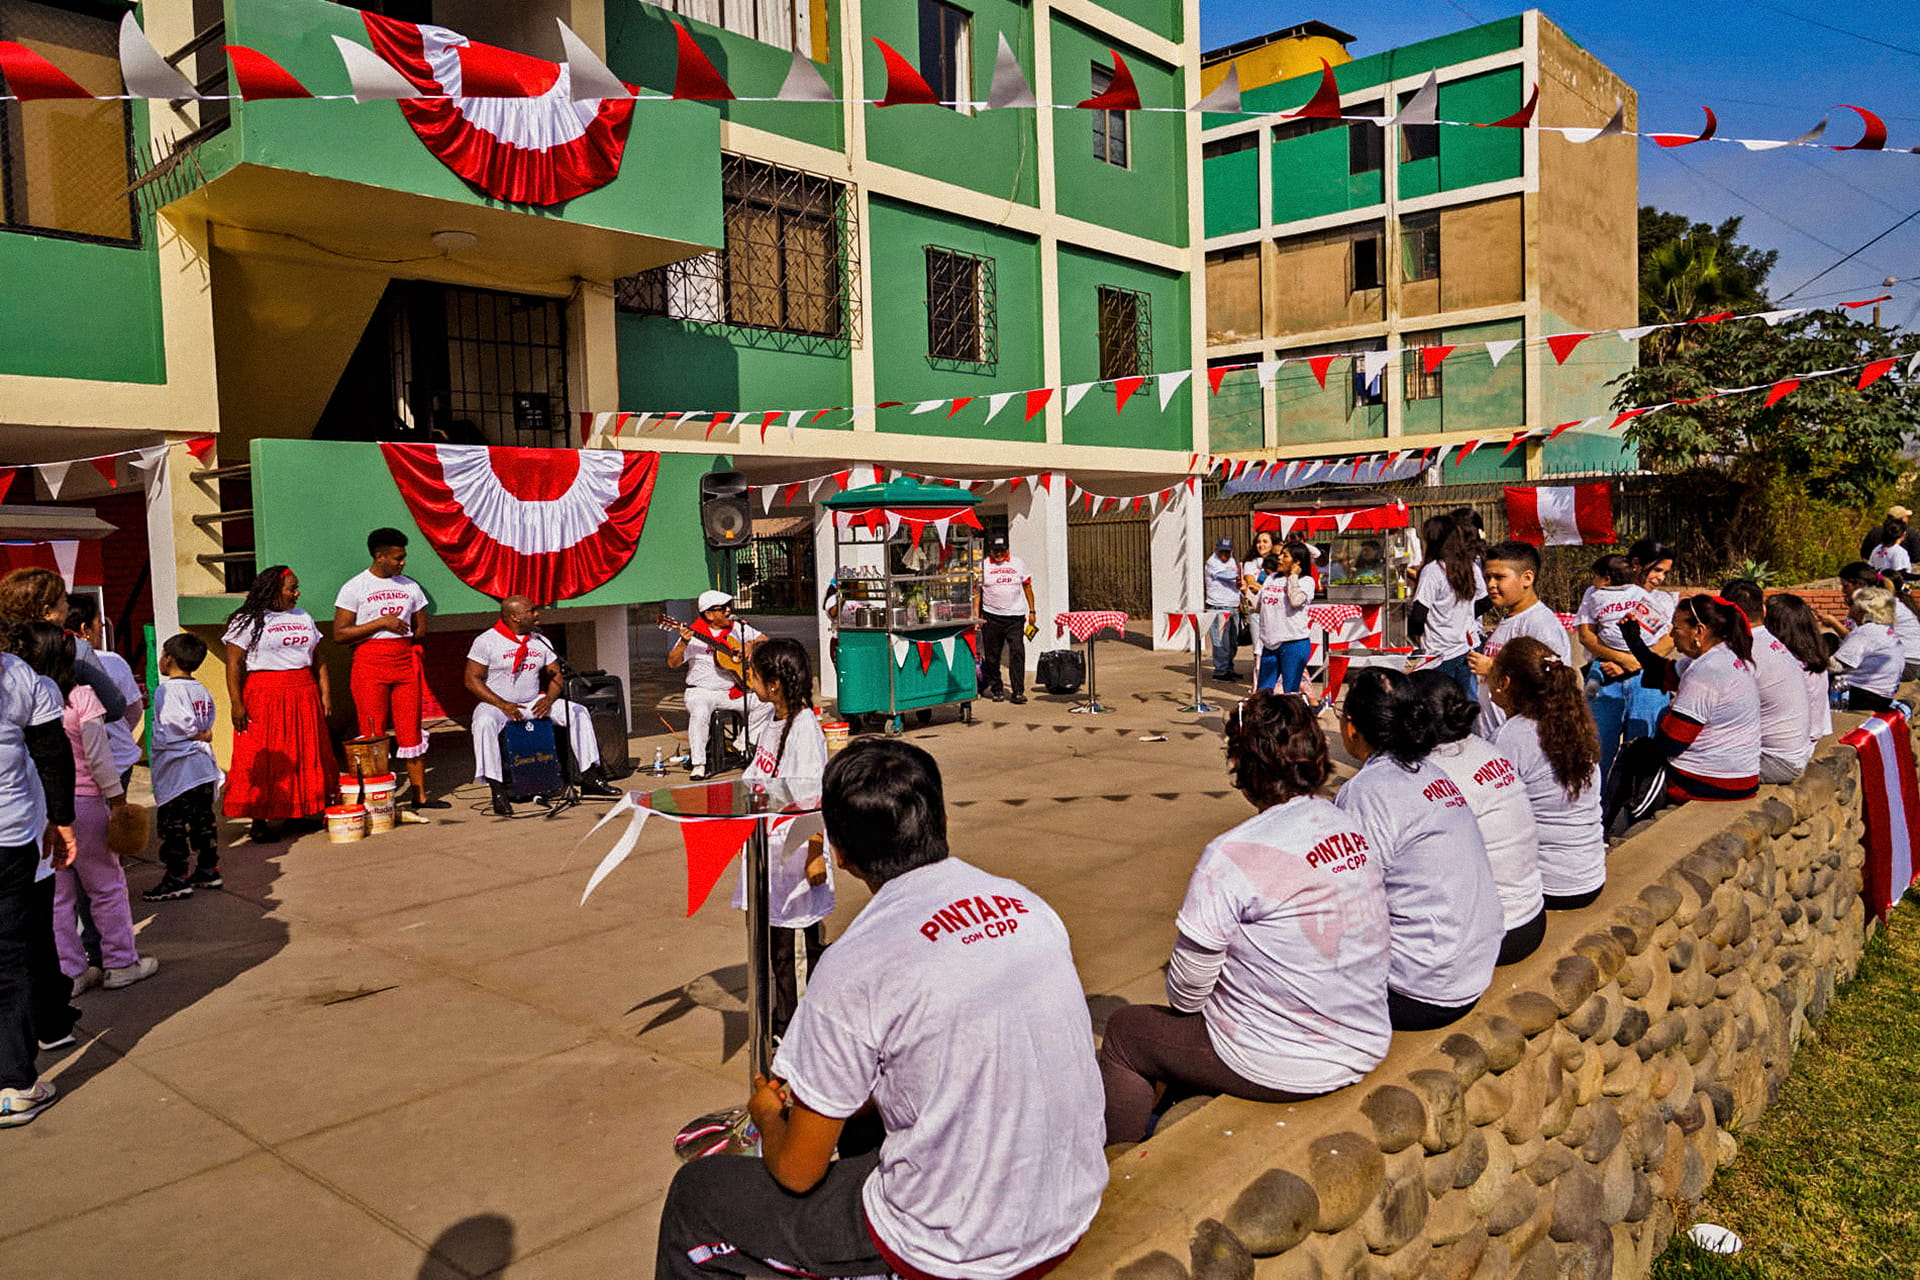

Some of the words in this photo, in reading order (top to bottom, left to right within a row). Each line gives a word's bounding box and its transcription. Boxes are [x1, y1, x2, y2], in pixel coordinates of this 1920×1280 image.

[282, 636, 309, 646] CPP
[1305, 832, 1369, 869] PINTAPE
[1332, 864, 1347, 873] CON
[1346, 853, 1367, 871] CPP
[920, 895, 1029, 942] PINTAPE
[961, 932, 984, 944] CON
[984, 918, 1018, 938] CPP
